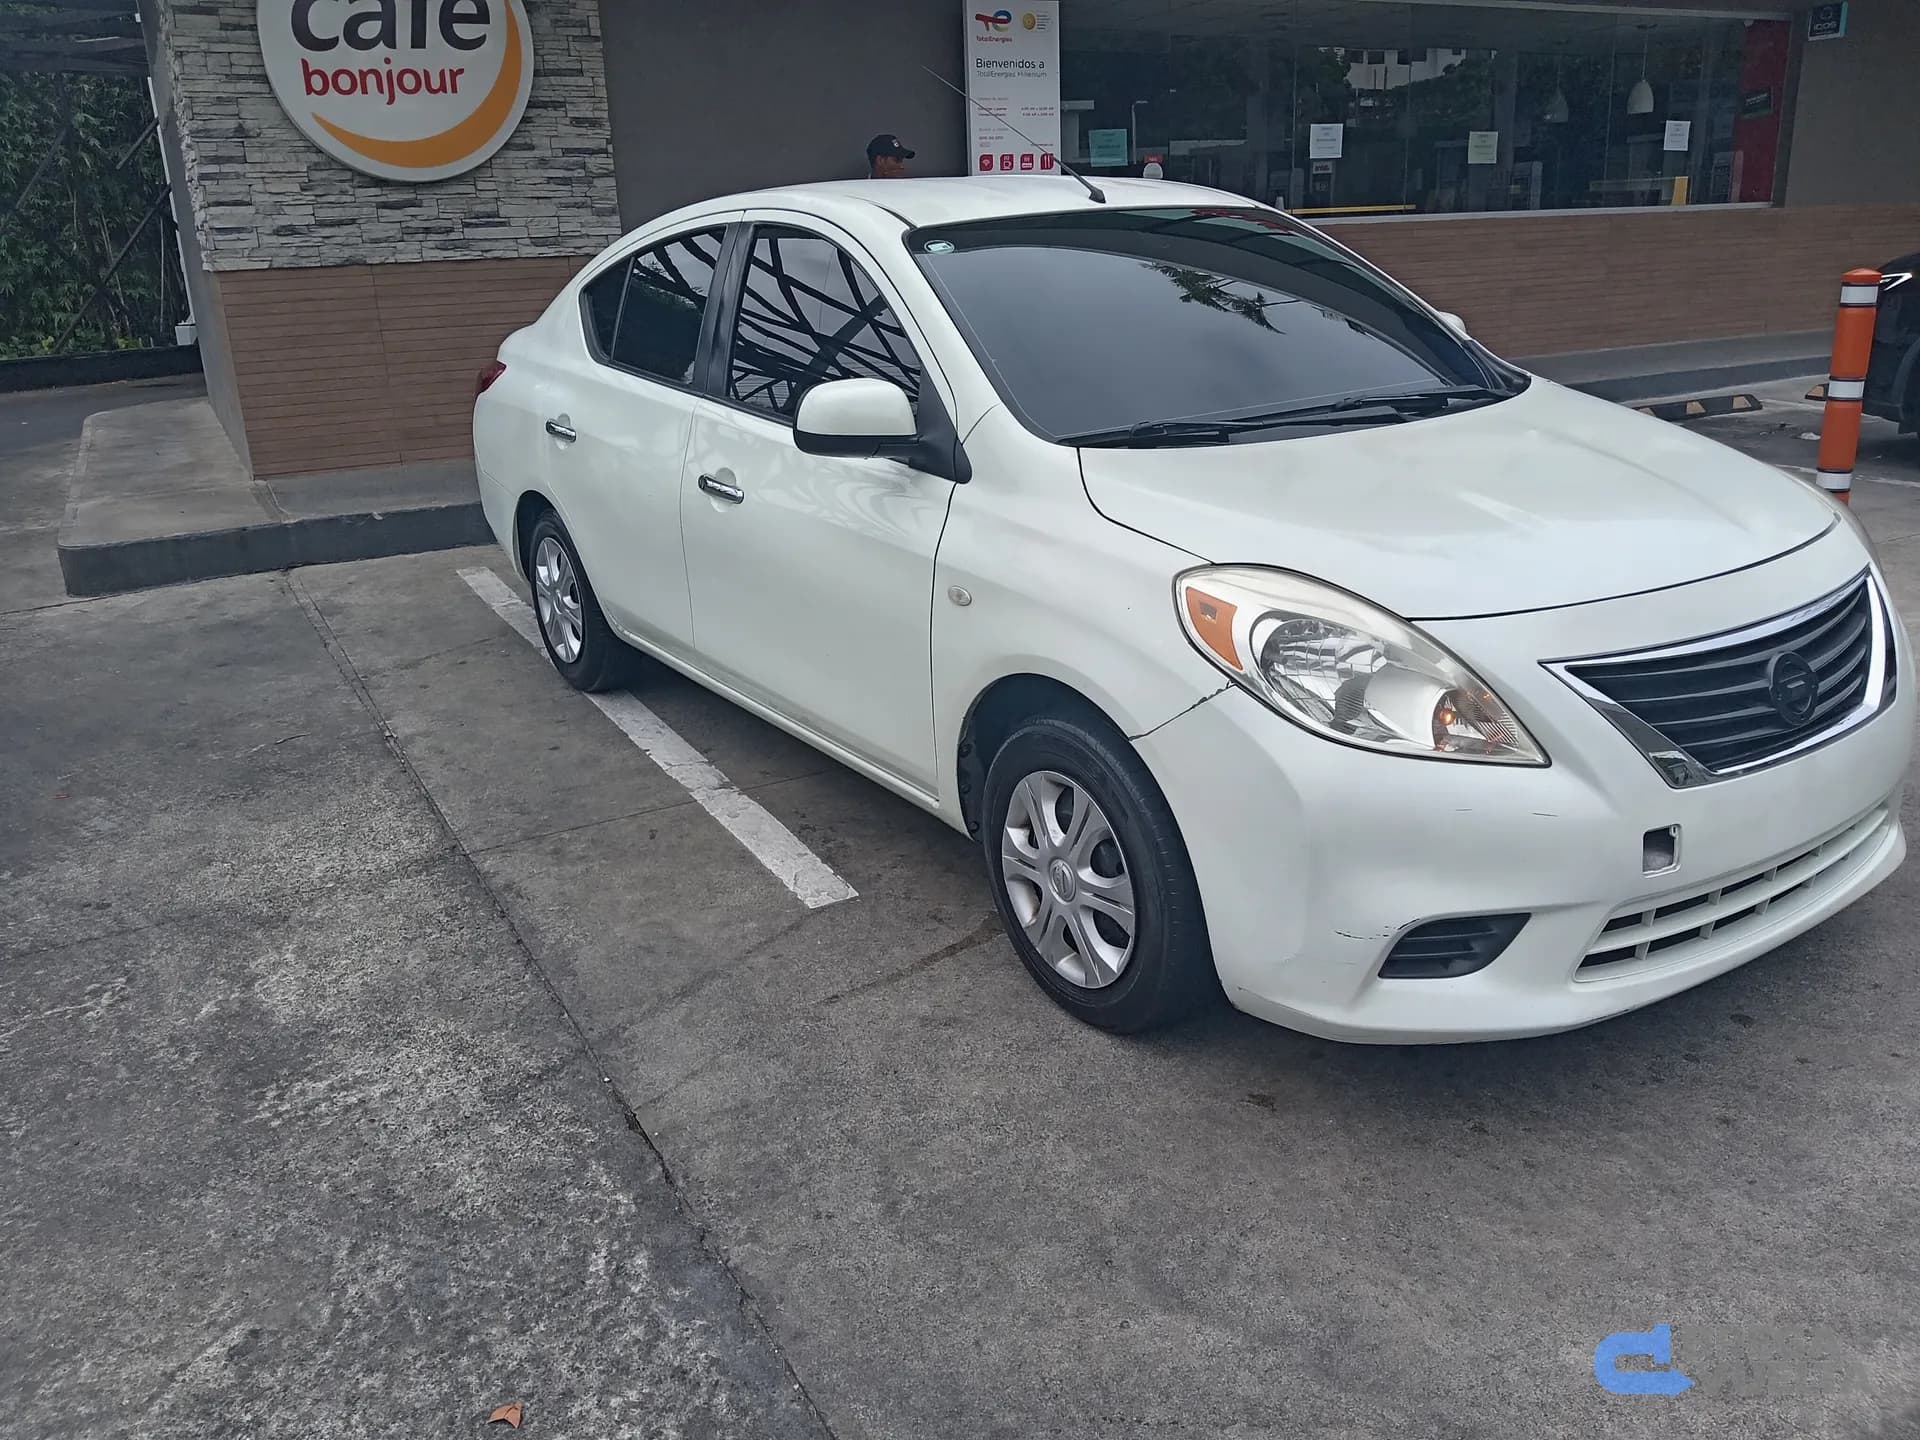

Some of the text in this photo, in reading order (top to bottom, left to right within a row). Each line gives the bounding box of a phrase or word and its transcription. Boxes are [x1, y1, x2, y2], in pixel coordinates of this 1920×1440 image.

[976, 58, 1045, 69] Bienvenidos a
[301, 57, 464, 105] bonjour
